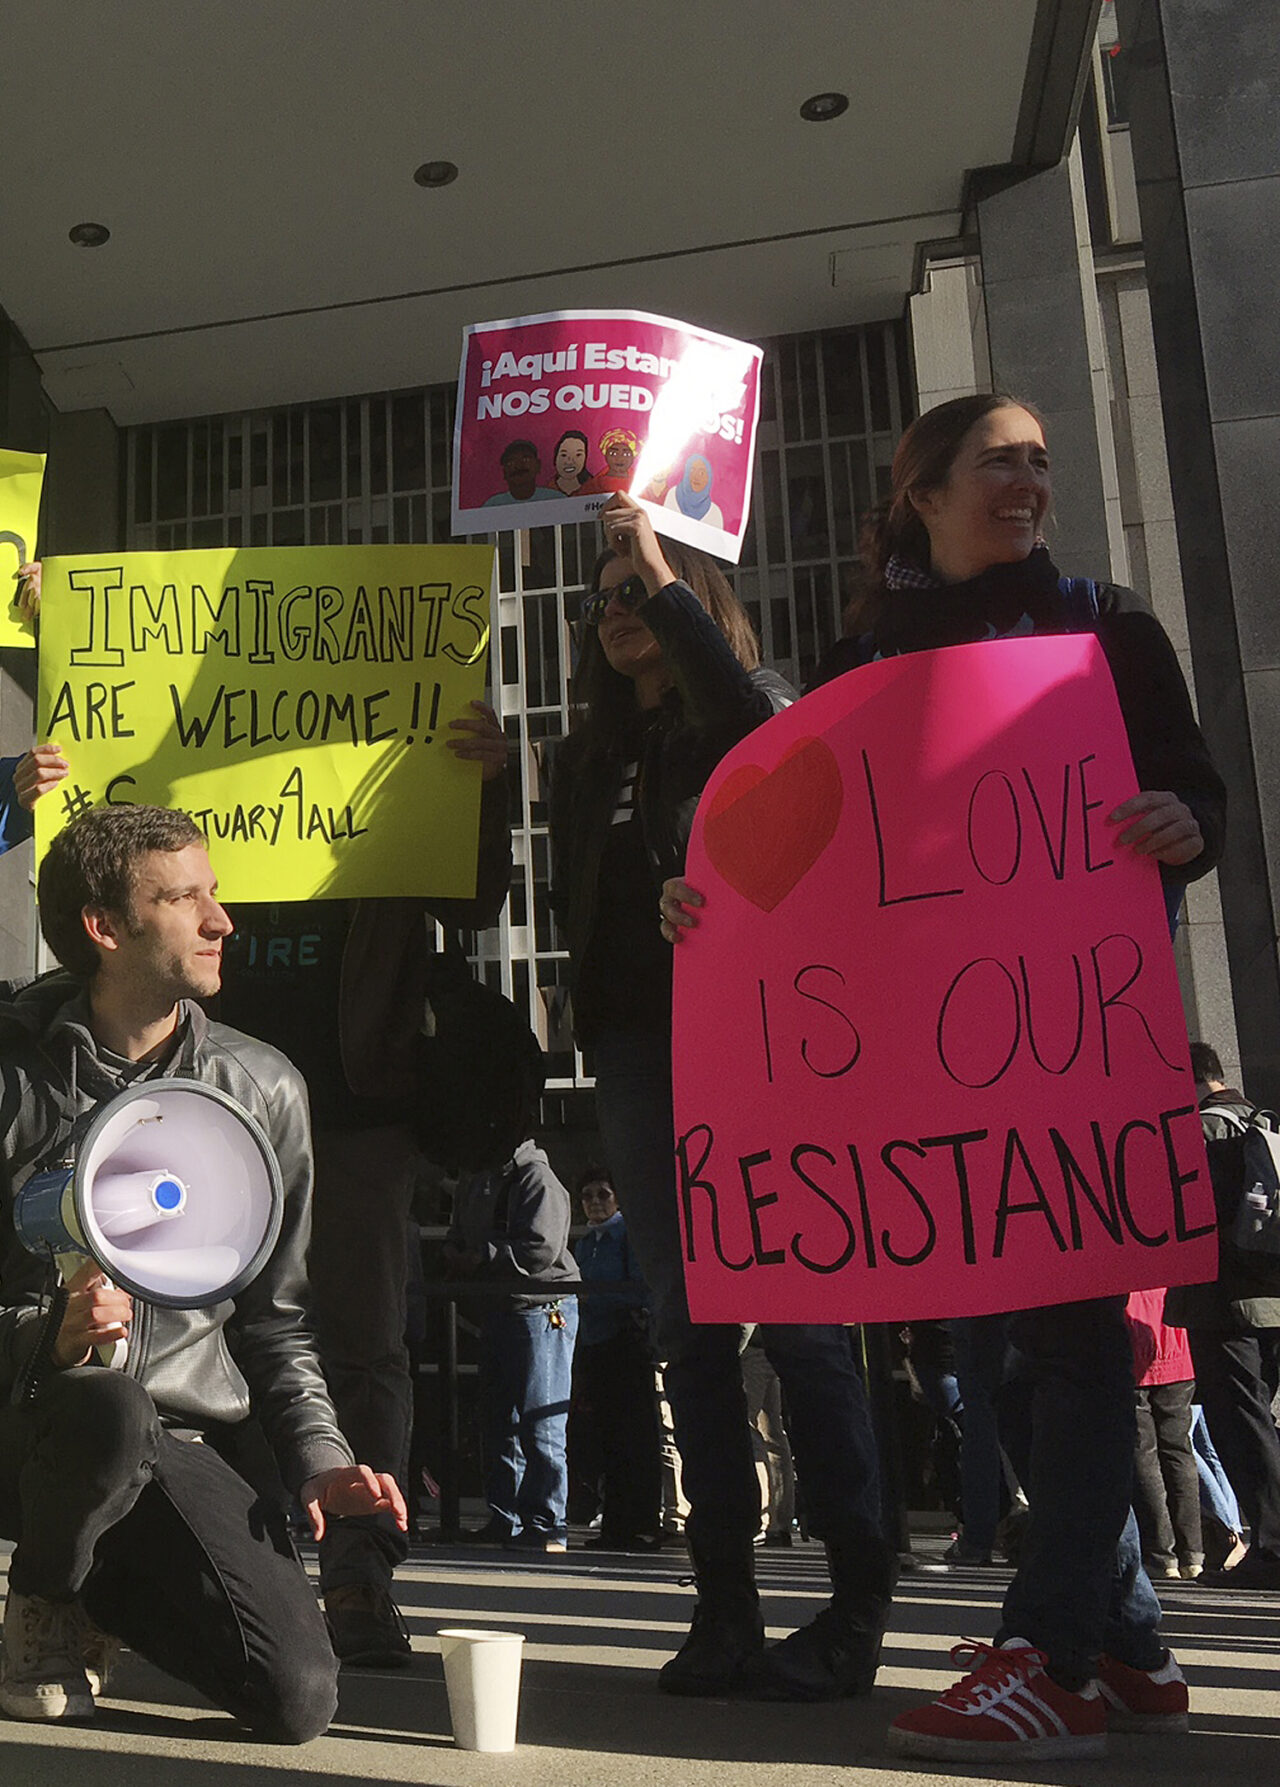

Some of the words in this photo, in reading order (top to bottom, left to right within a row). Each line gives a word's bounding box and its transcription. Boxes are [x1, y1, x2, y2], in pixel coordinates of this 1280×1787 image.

[477, 390, 551, 421] NOS
[480, 343, 578, 388] ¡Aquí
[68, 566, 488, 667] IMMIGRANTS
[46, 680, 136, 742] ARE
[169, 682, 442, 749] WELCOME!!
[862, 748, 1114, 908] LOVE
[757, 963, 861, 1084] IS
[936, 933, 1186, 1089] OUR
[675, 1104, 1217, 1275] RESISTANCE
